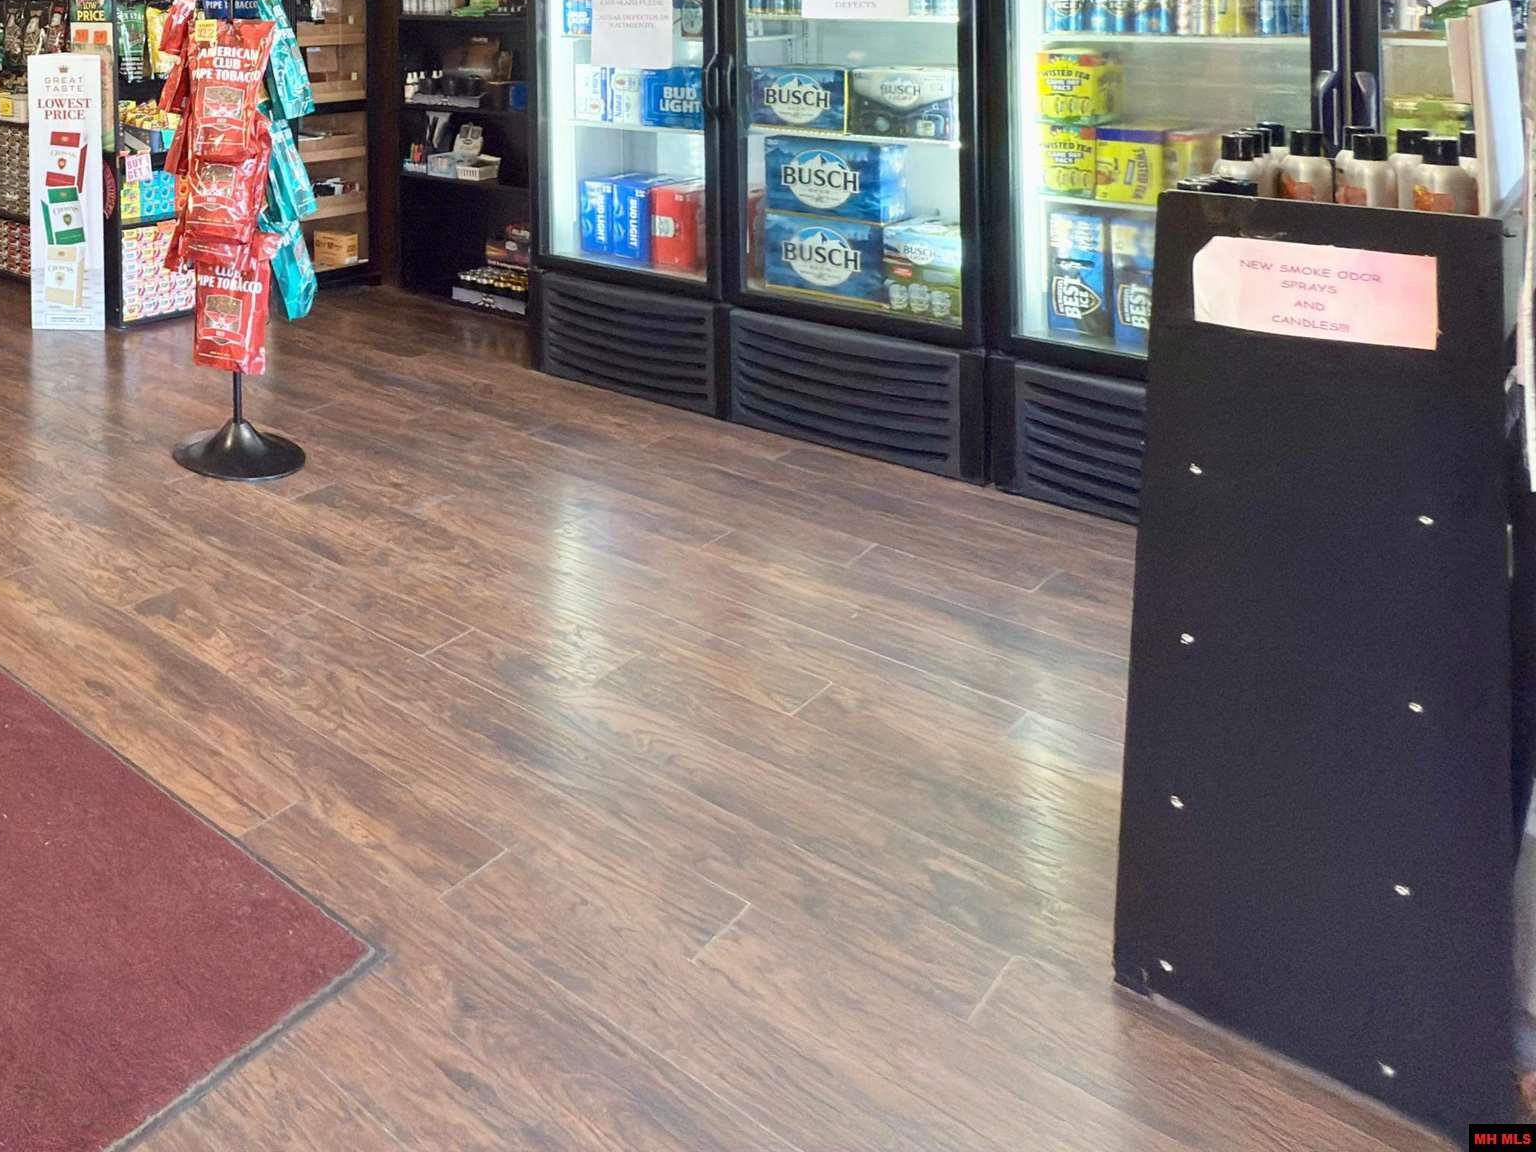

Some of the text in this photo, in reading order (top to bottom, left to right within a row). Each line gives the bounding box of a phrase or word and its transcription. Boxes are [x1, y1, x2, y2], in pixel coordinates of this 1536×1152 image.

[206, 0, 224, 9] PIPE
[77, 10, 106, 21] PRICE
[199, 46, 259, 60] AMERICAN
[213, 57, 242, 69] CLUB
[45, 76, 84, 85] GREAT
[216, 69, 262, 82] TOBACCO
[46, 84, 84, 93] TASTE
[663, 86, 697, 100] BUD
[880, 83, 921, 96] BUSCH
[38, 98, 92, 109] LOWEST
[765, 88, 830, 108] BUSCH
[659, 100, 702, 113] LIGHT
[44, 108, 86, 121] PRICE
[782, 165, 859, 192] BUSCH
[782, 242, 861, 271] BUSCH
[904, 245, 936, 256] BUSCH
[1240, 259, 1383, 283] NEW SMOKE ODOR
[216, 277, 263, 294] TOBACCO
[1281, 279, 1338, 295] SPRAYS
[1294, 299, 1326, 311] AND
